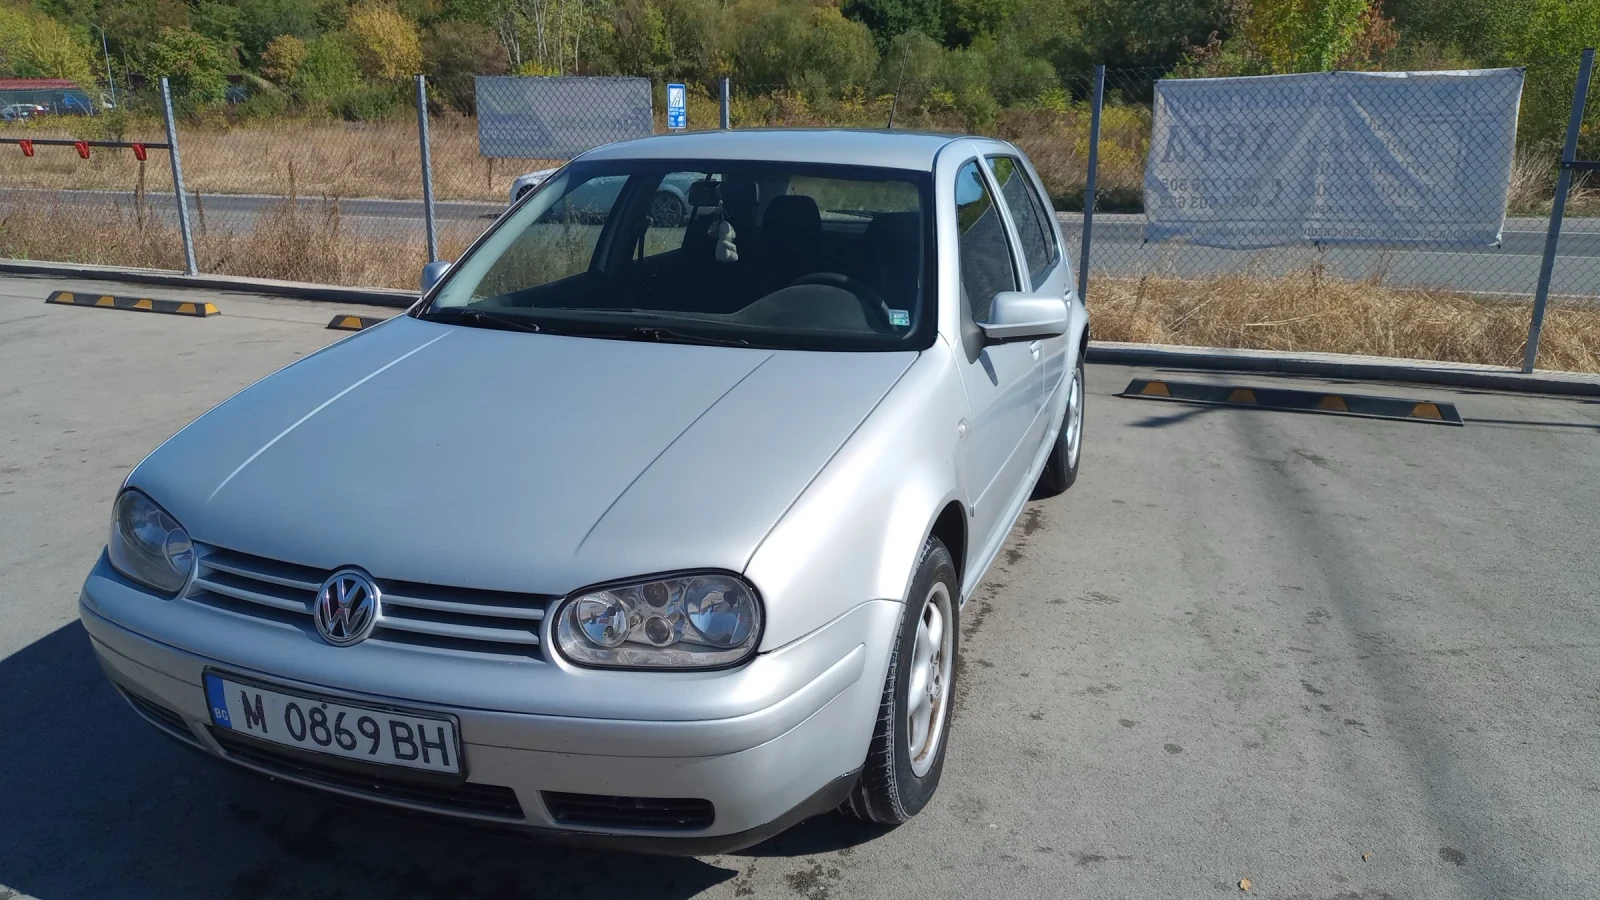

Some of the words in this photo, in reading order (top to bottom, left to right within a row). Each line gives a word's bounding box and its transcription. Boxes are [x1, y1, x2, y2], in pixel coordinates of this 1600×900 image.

[213, 707, 229, 721] BG
[240, 690, 268, 734] M
[284, 702, 381, 756] 0869
[388, 720, 450, 767] BH
